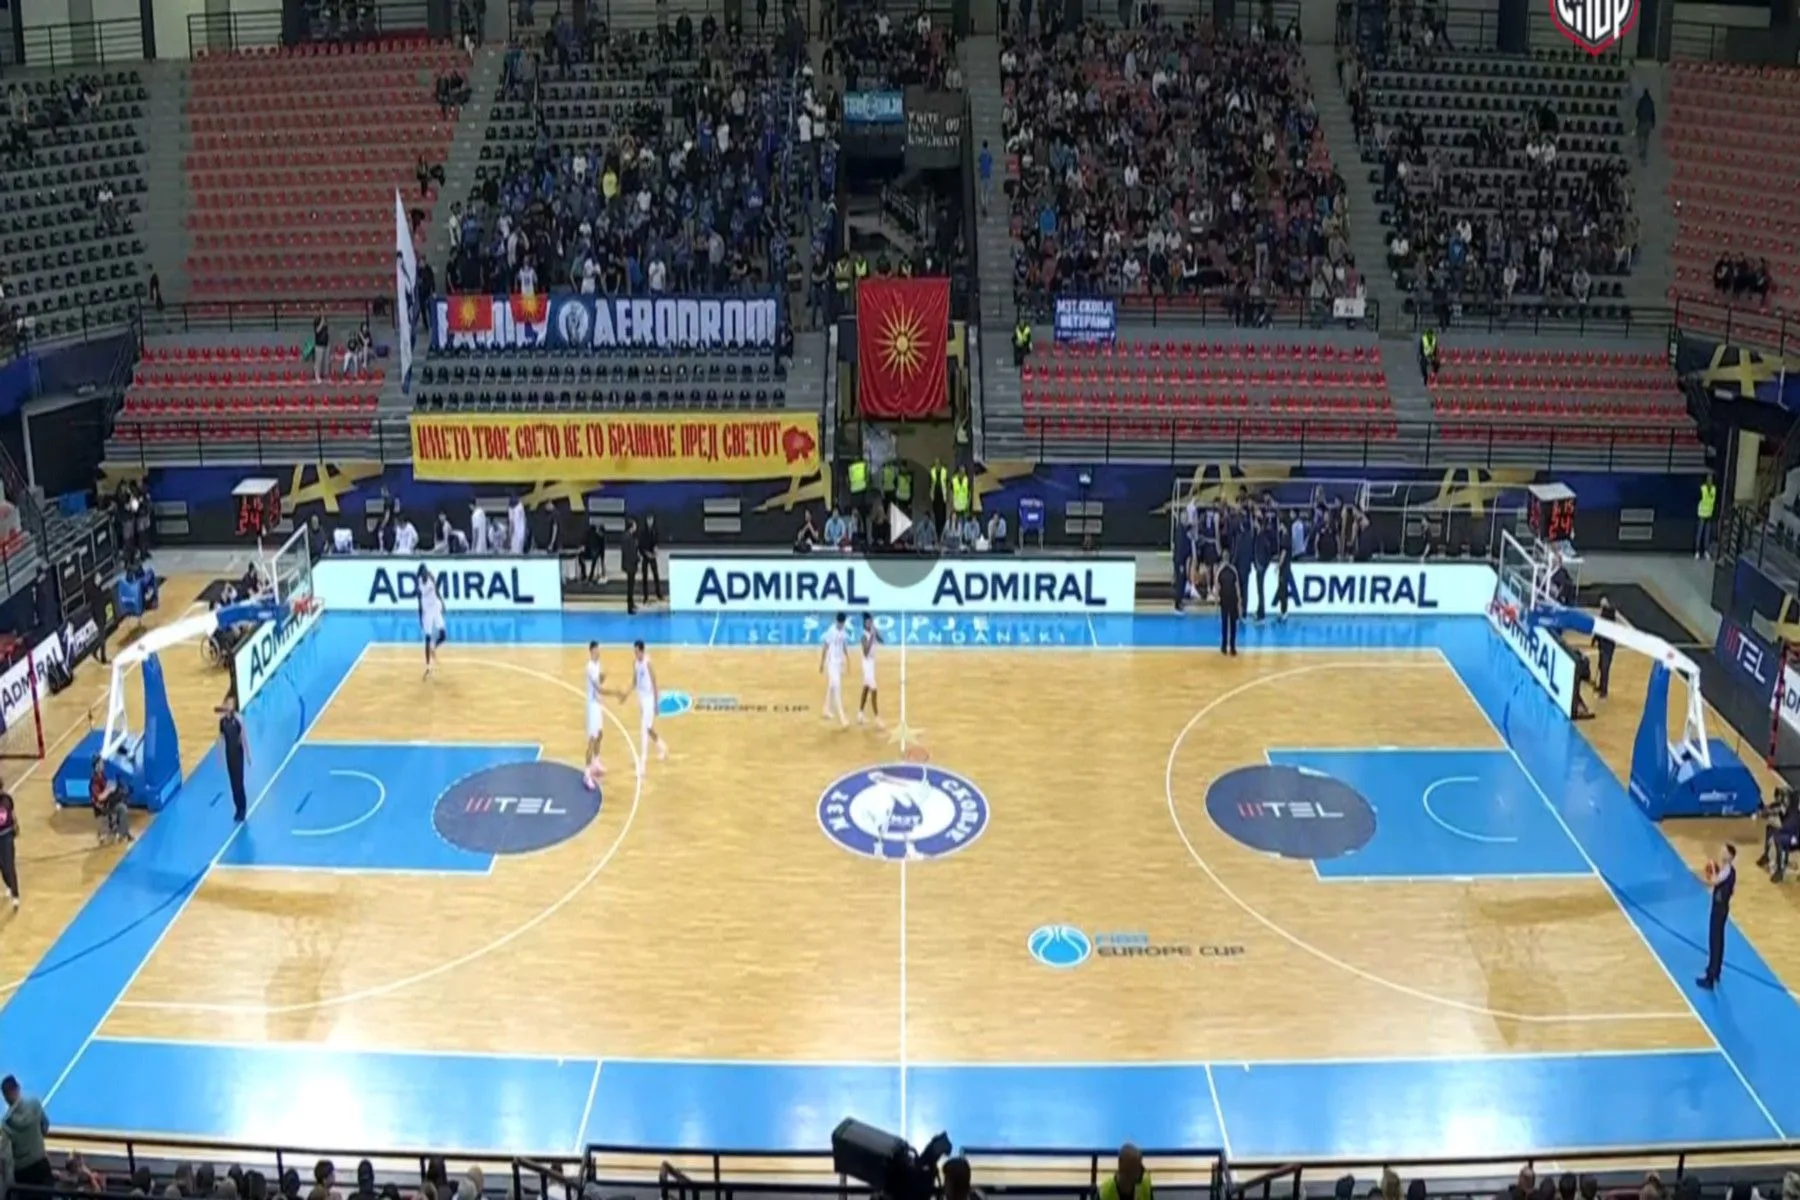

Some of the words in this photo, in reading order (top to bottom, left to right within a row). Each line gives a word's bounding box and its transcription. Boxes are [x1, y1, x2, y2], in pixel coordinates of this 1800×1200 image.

[593, 299, 777, 348] AERODROM
[417, 425, 471, 461] ИМЕТО
[472, 425, 513, 461] ТВОЕ
[515, 423, 560, 459] СВЕТО
[586, 423, 605, 458] ГО
[608, 423, 676, 459] БРАНИМЕ
[681, 423, 719, 463] ПРЕД
[722, 421, 782, 458] СВЕТОТ
[695, 566, 870, 606] ADMIRAL
[931, 567, 1107, 607] ADMIRAL
[1271, 571, 1439, 609] ADMIRAL
[1097, 945, 1192, 957] EUROPE
[1199, 945, 1245, 956] CUP
